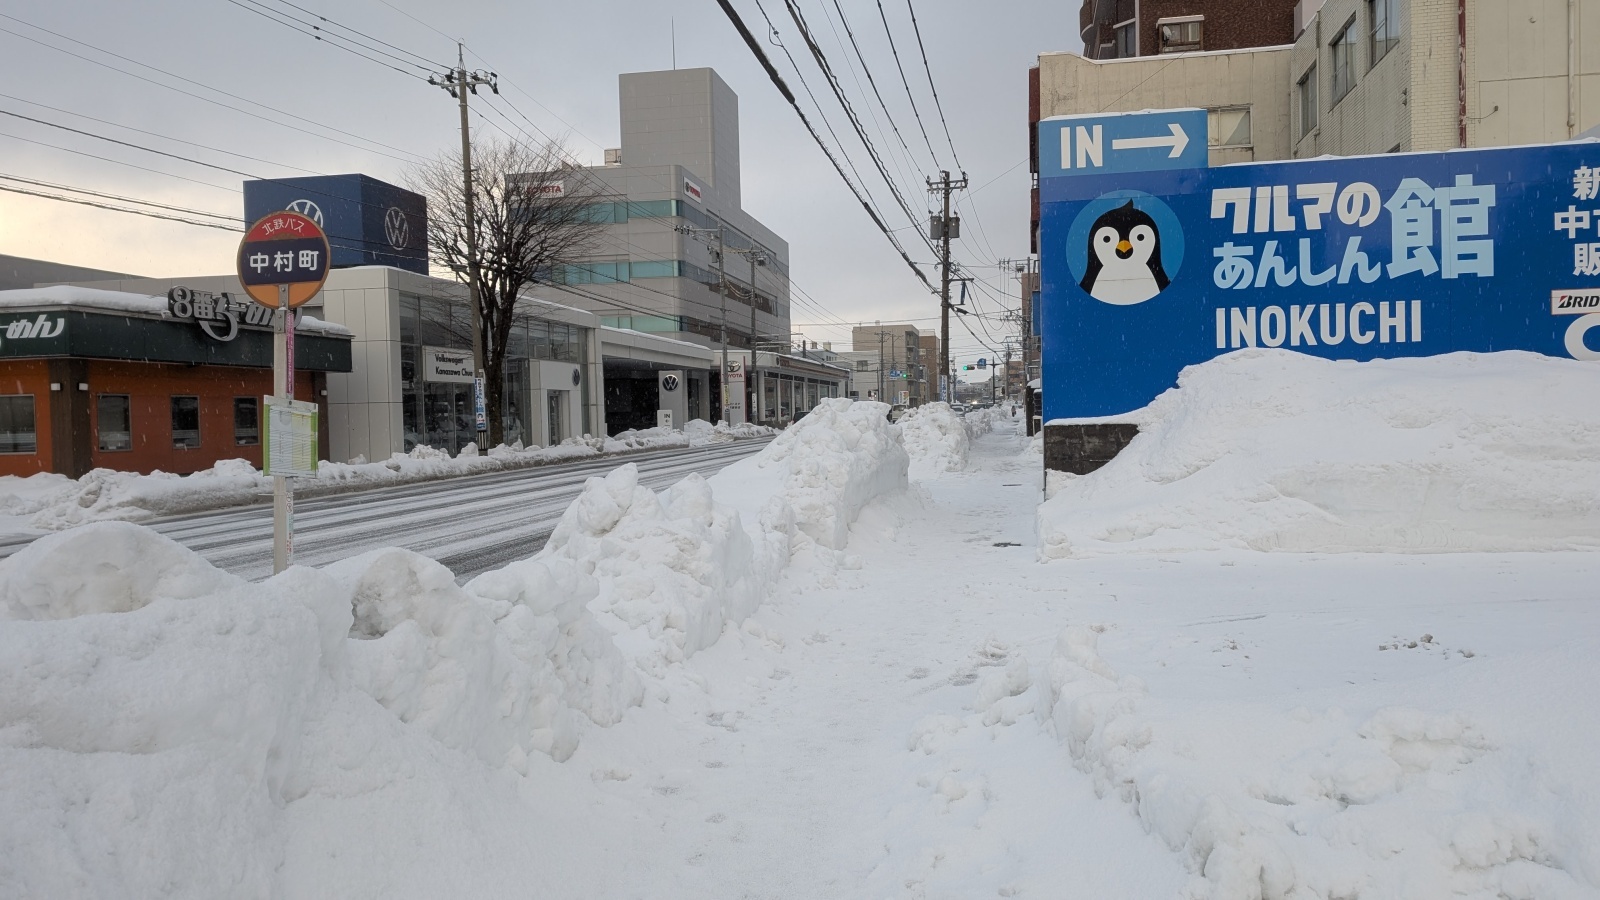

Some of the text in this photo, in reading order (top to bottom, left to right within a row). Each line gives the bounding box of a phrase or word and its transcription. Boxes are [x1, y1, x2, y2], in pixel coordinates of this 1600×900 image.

[1060, 124, 1103, 169] IN
[261, 218, 305, 235] 北鉄バス
[1210, 182, 1381, 234] クルマの
[1383, 174, 1496, 279] 館
[1554, 204, 1600, 239] 中
[249, 250, 319, 274] 中村町
[1213, 235, 1382, 290] あんしん
[170, 285, 303, 342] 8番らーめ
[1215, 300, 1422, 349] INOKUCHI
[435, 354, 464, 366] Volkswagen
[436, 366, 461, 376] Kanazawa
